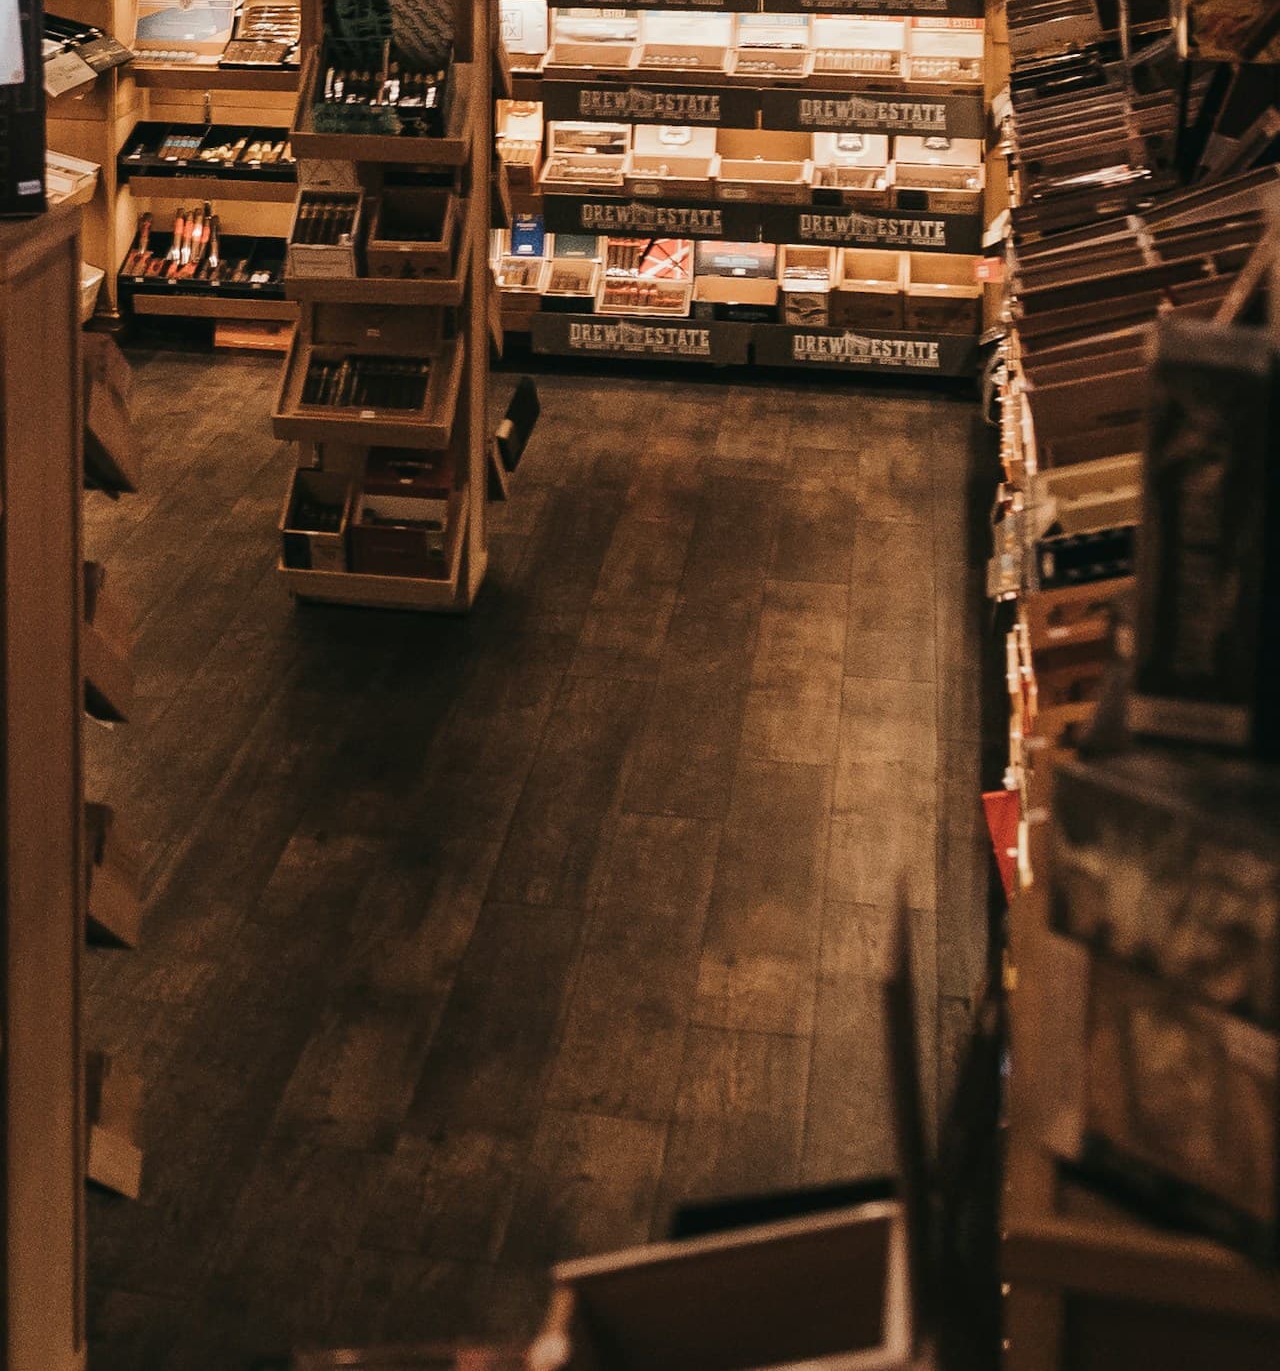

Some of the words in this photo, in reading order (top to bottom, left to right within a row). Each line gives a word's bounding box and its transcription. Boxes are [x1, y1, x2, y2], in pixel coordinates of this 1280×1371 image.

[580, 89, 628, 108] DREW
[655, 93, 720, 112] ESTATE
[801, 99, 852, 118] DREW
[878, 103, 946, 122] ESTATE
[583, 204, 632, 223] DREW
[657, 207, 723, 226] ESTATE
[800, 214, 853, 233] DREW
[877, 219, 945, 238] ESTATE
[570, 323, 620, 343] DREW
[646, 327, 711, 347] ESTATE
[794, 334, 847, 354] DREW
[872, 339, 940, 360] ESTATE
